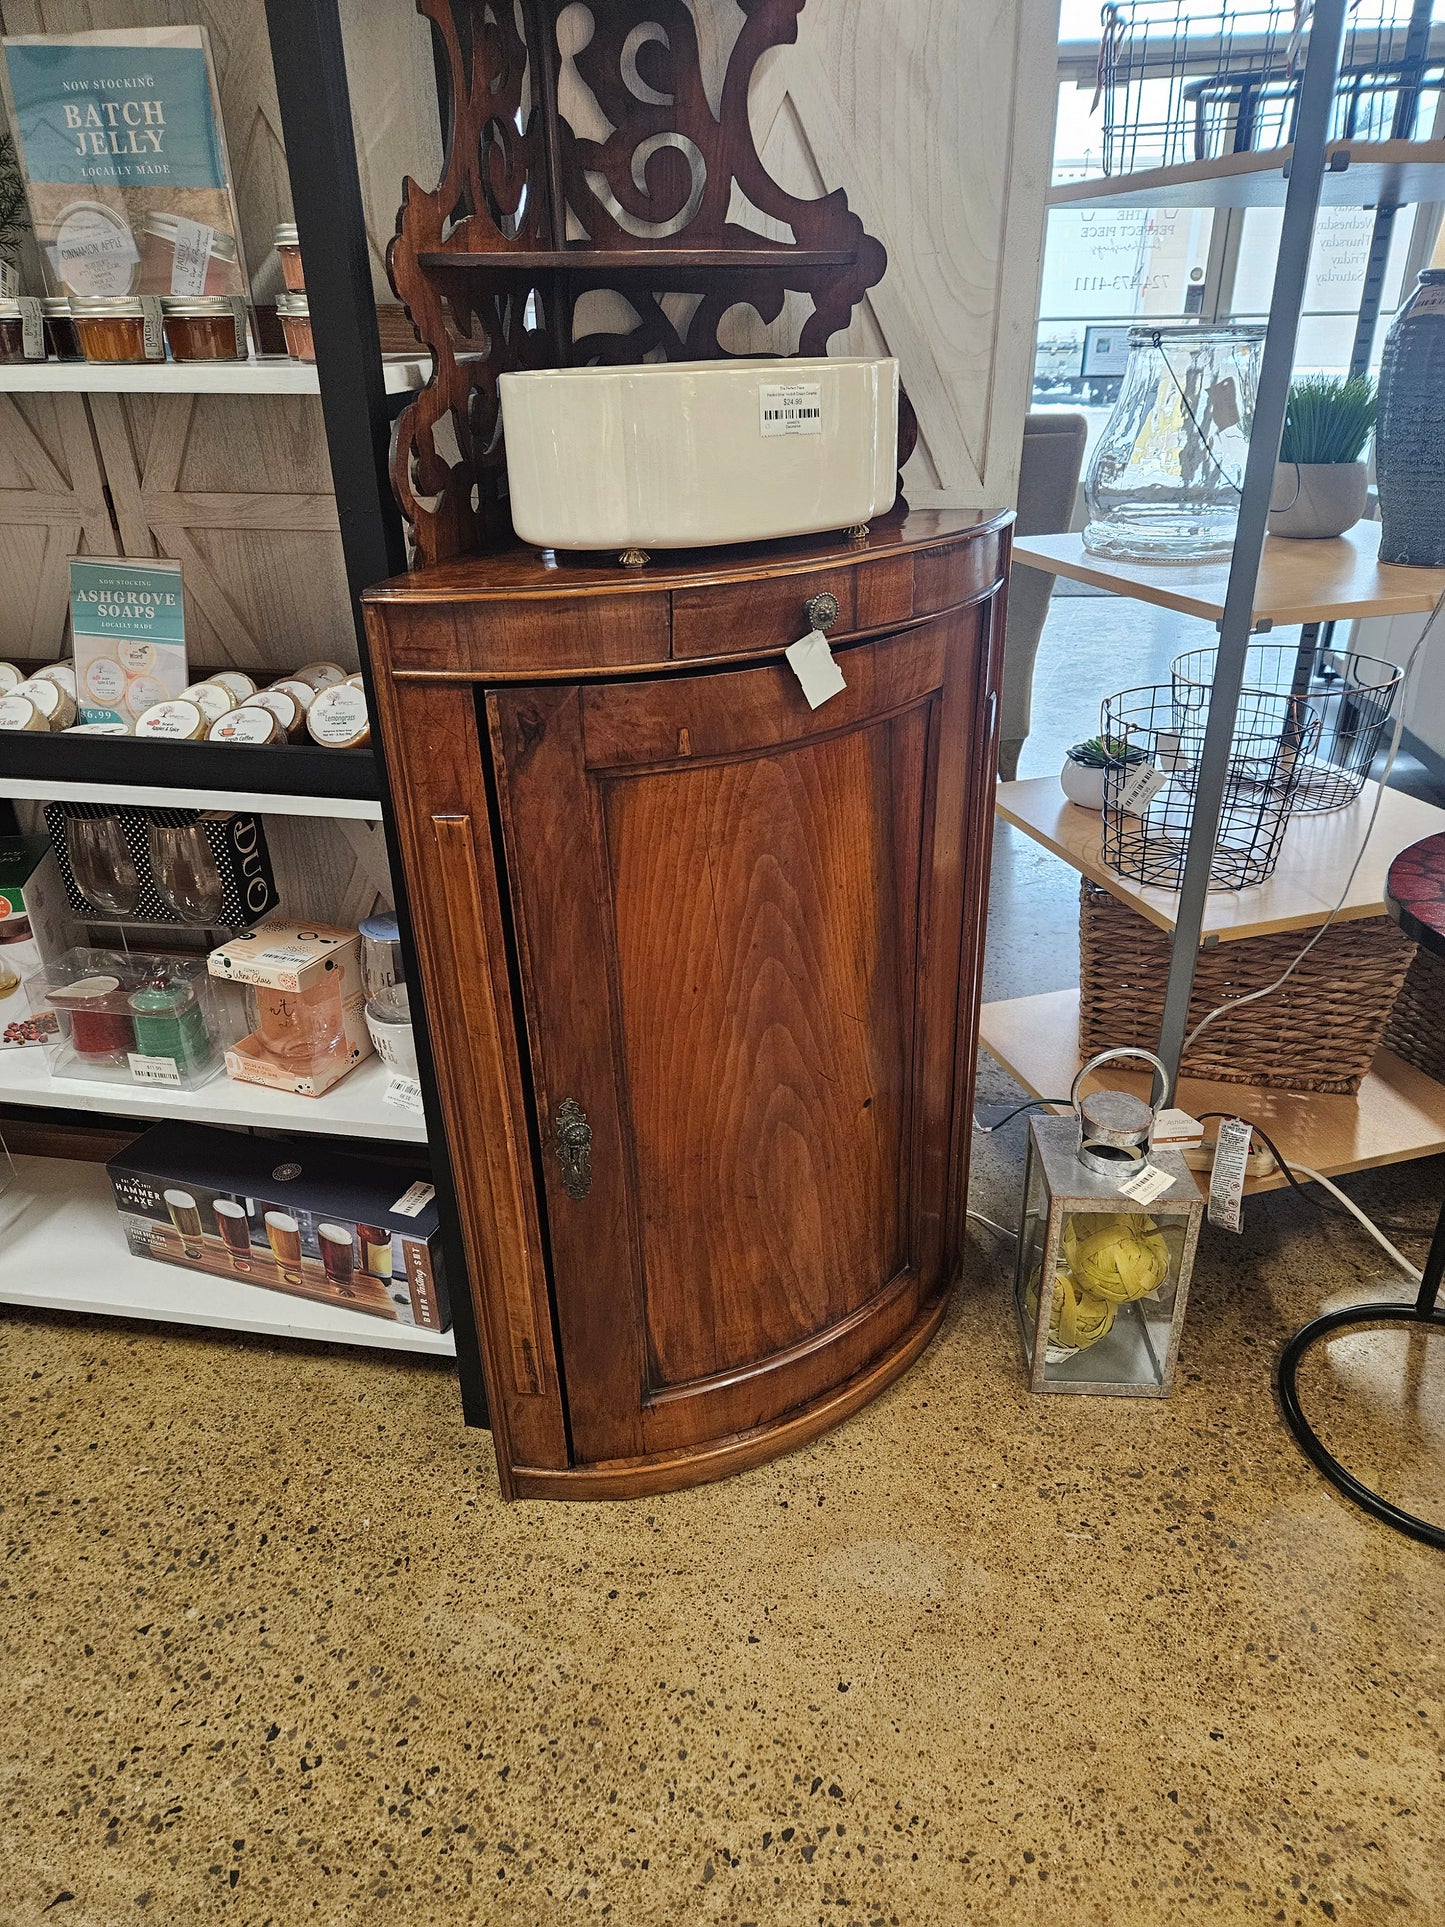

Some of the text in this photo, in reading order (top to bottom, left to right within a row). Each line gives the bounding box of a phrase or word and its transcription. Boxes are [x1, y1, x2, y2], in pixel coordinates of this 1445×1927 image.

[63, 77, 154, 92] NOW STOCKING
[63, 101, 167, 129] BATCH
[75, 129, 165, 156] JELLY
[81, 164, 171, 177] LOCALLY MADE
[61, 236, 123, 260] CINNAMON APPLE
[783, 398, 803, 406] $24.99
[76, 589, 176, 606] ASHGROVE
[97, 604, 155, 619] SOAPS
[101, 621, 131, 629] LOCALLY
[80, 710, 112, 719] $6.99
[325, 714, 356, 722] Lemongrass
[115, 1182, 161, 1201] HAMMER
[411, 1247, 422, 1266] SET
[420, 1298, 431, 1323] BEER
